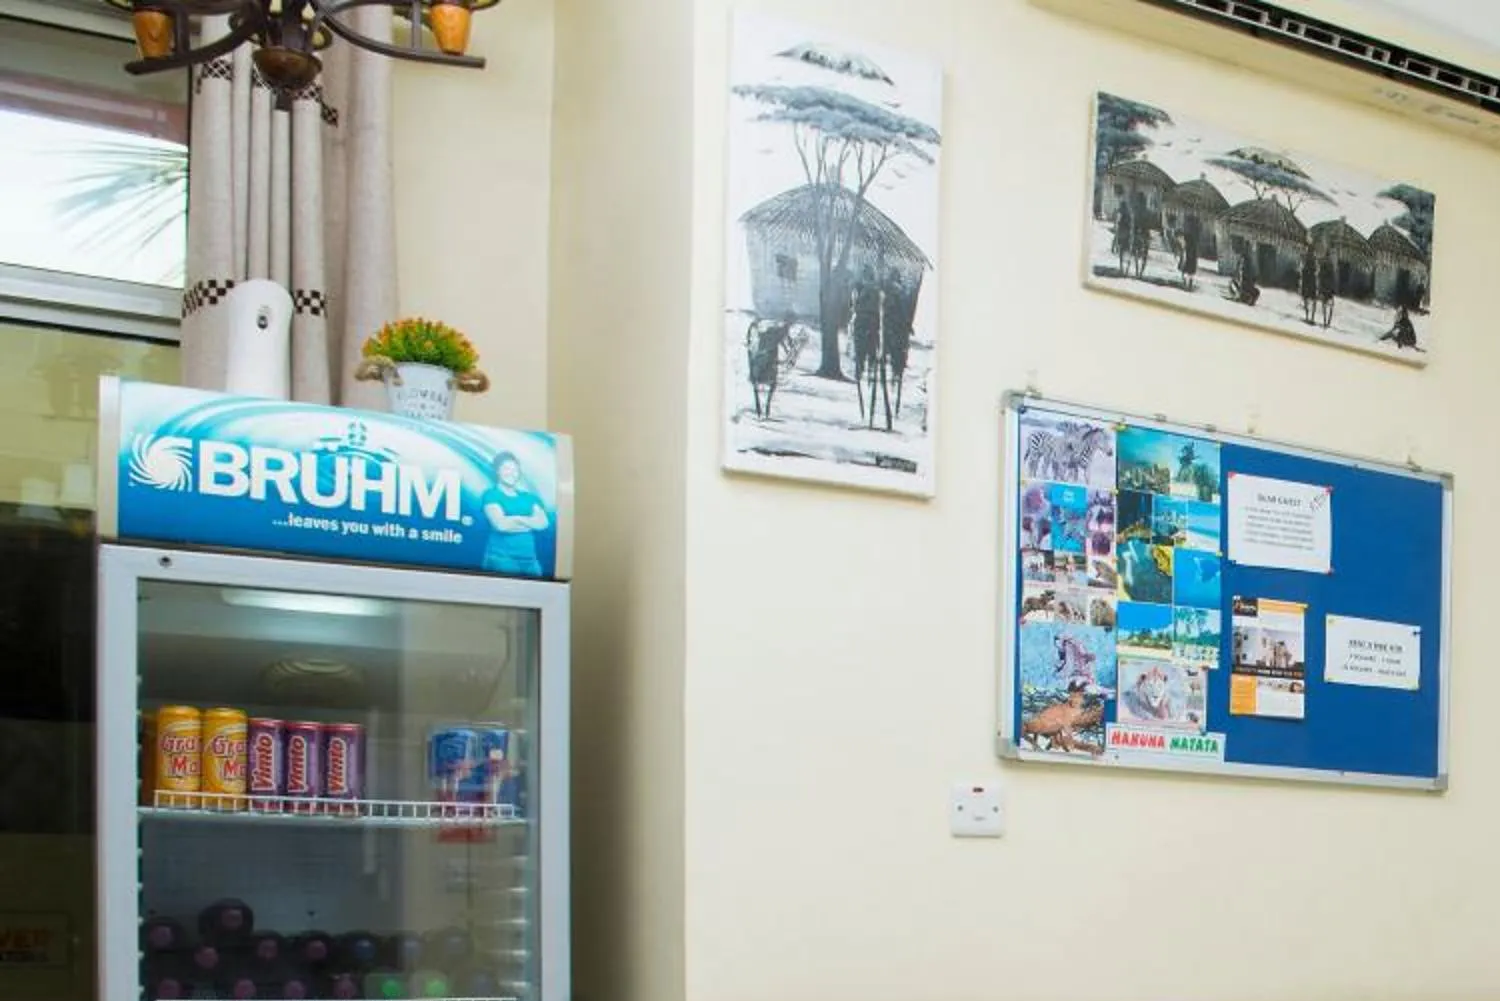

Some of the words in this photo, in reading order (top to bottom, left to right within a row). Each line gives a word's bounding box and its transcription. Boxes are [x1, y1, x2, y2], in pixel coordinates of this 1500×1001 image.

[198, 438, 463, 521] BRUHM
[341, 518, 369, 536] you
[371, 521, 405, 538] with
[408, 527, 419, 539] a
[421, 527, 463, 544] smile
[252, 733, 276, 791] Vimto
[287, 735, 308, 793] Vimto
[327, 737, 348, 794] Vimto
[1111, 730, 1165, 749] HAKUNA
[1169, 735, 1219, 753] MATATA
